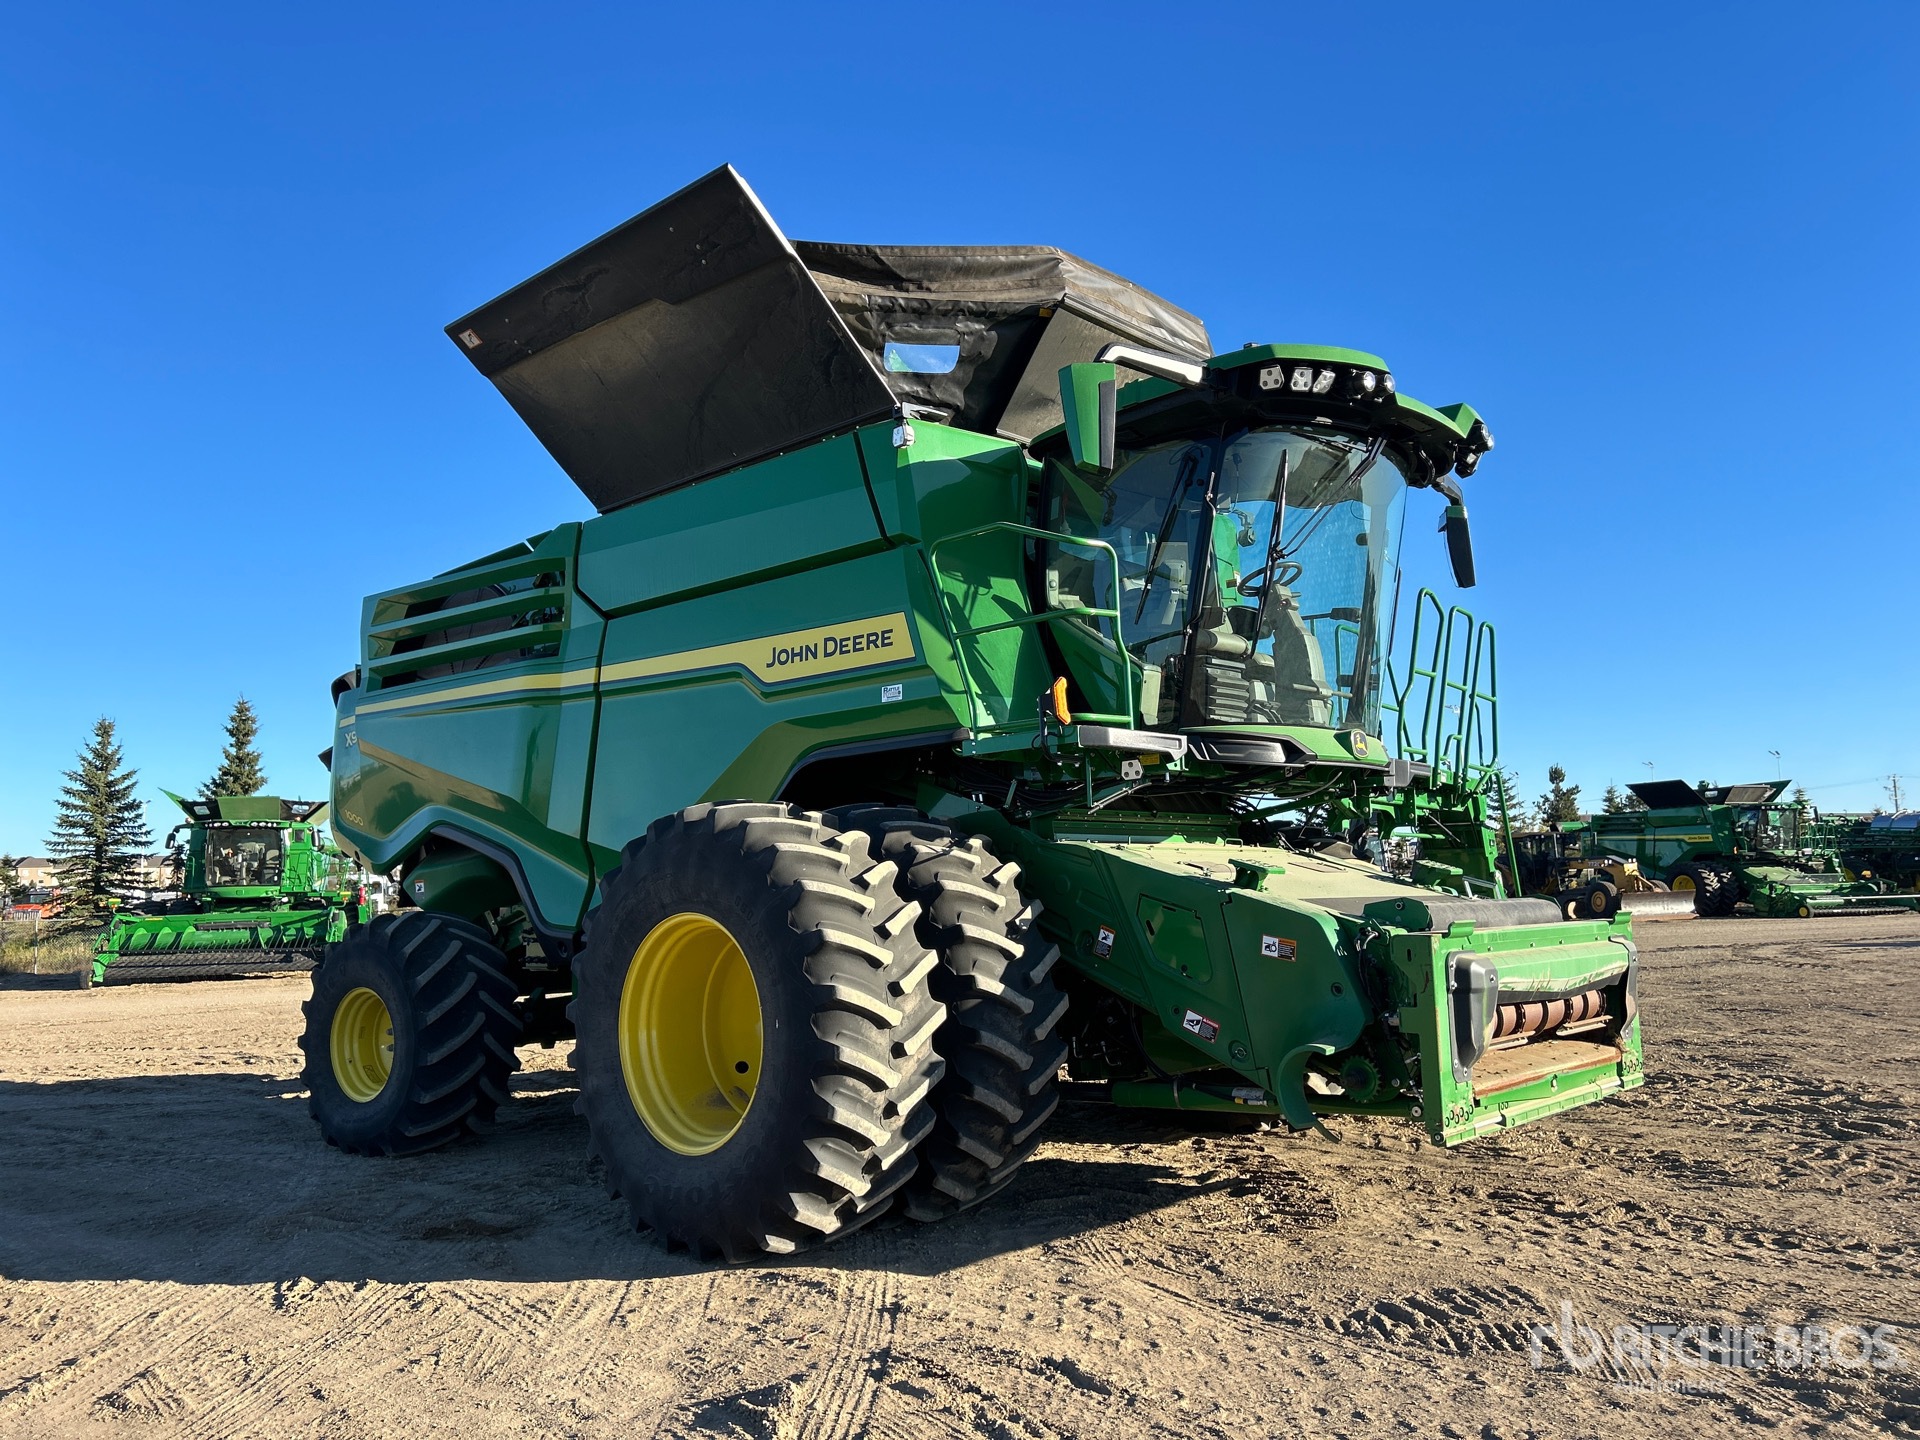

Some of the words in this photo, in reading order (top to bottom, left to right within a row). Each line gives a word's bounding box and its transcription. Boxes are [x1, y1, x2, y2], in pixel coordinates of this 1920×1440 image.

[766, 643, 818, 668] JOHN
[823, 629, 894, 658] DEERE
[345, 731, 358, 748] X9
[344, 809, 364, 826] 1000
